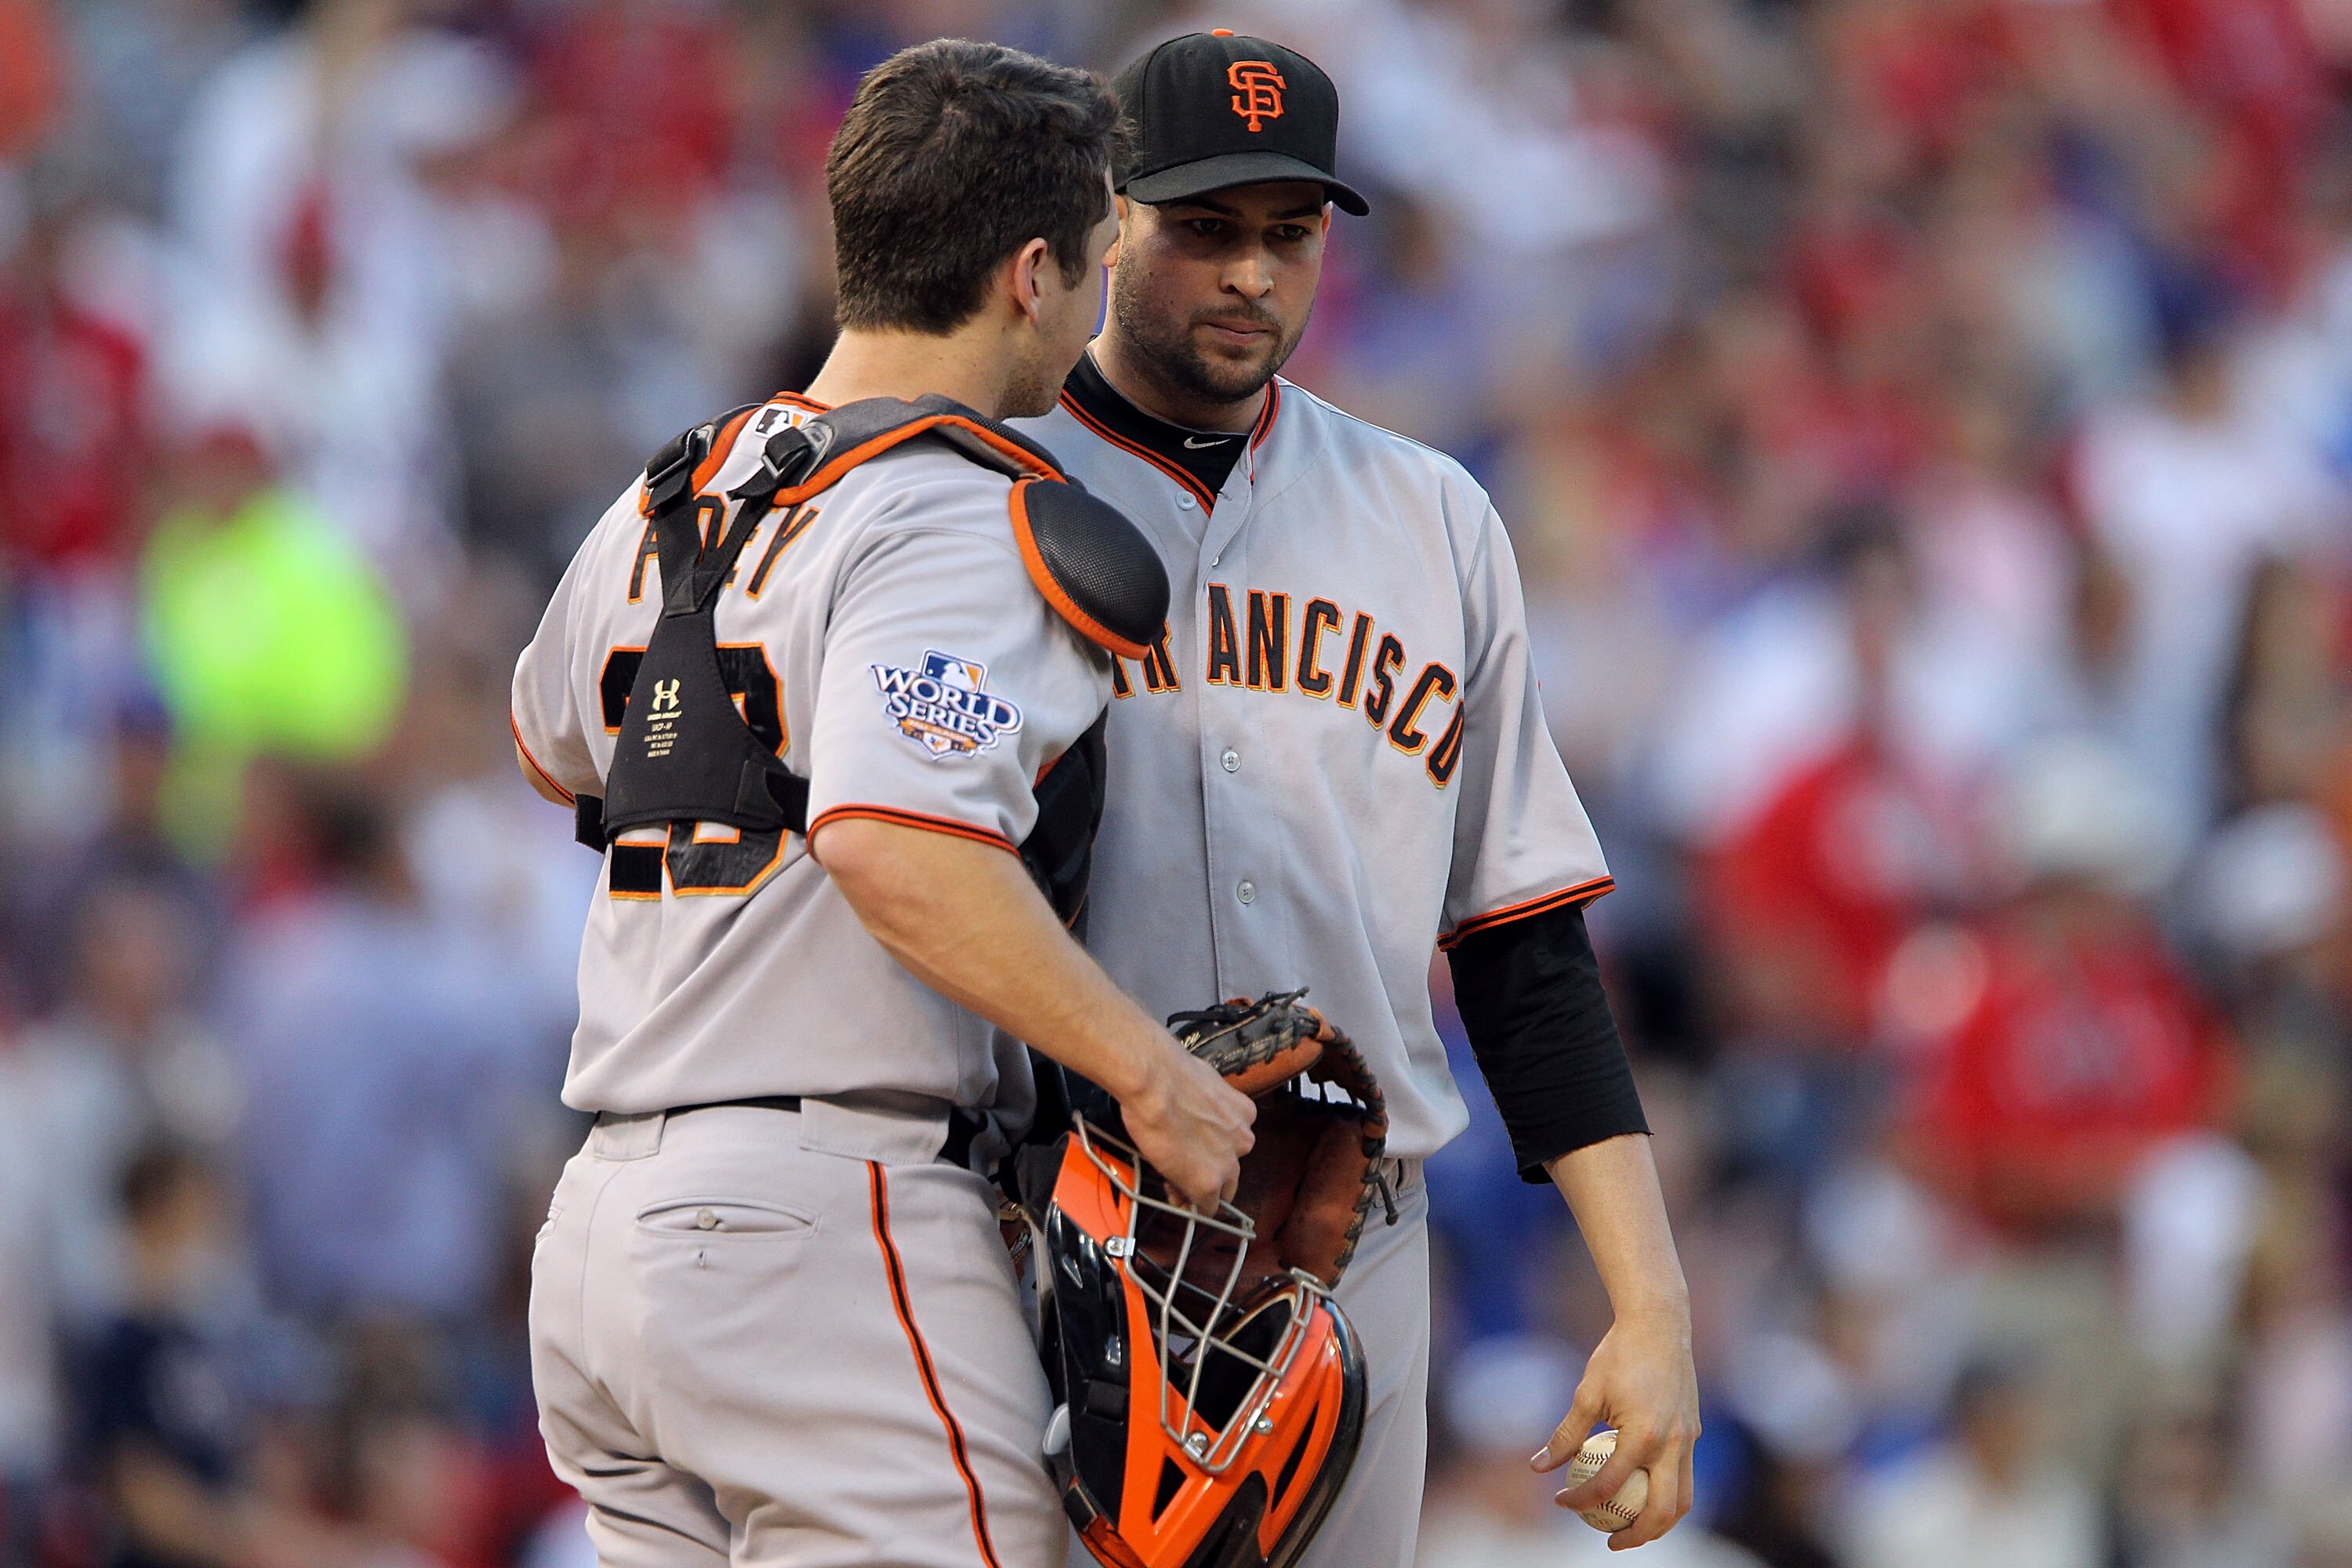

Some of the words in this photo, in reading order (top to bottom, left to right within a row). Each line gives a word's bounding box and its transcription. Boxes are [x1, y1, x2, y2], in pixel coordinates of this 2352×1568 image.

[1227, 60, 1287, 132] SF
[870, 665, 1019, 730] WORLD
[886, 691, 996, 745] SERIES
